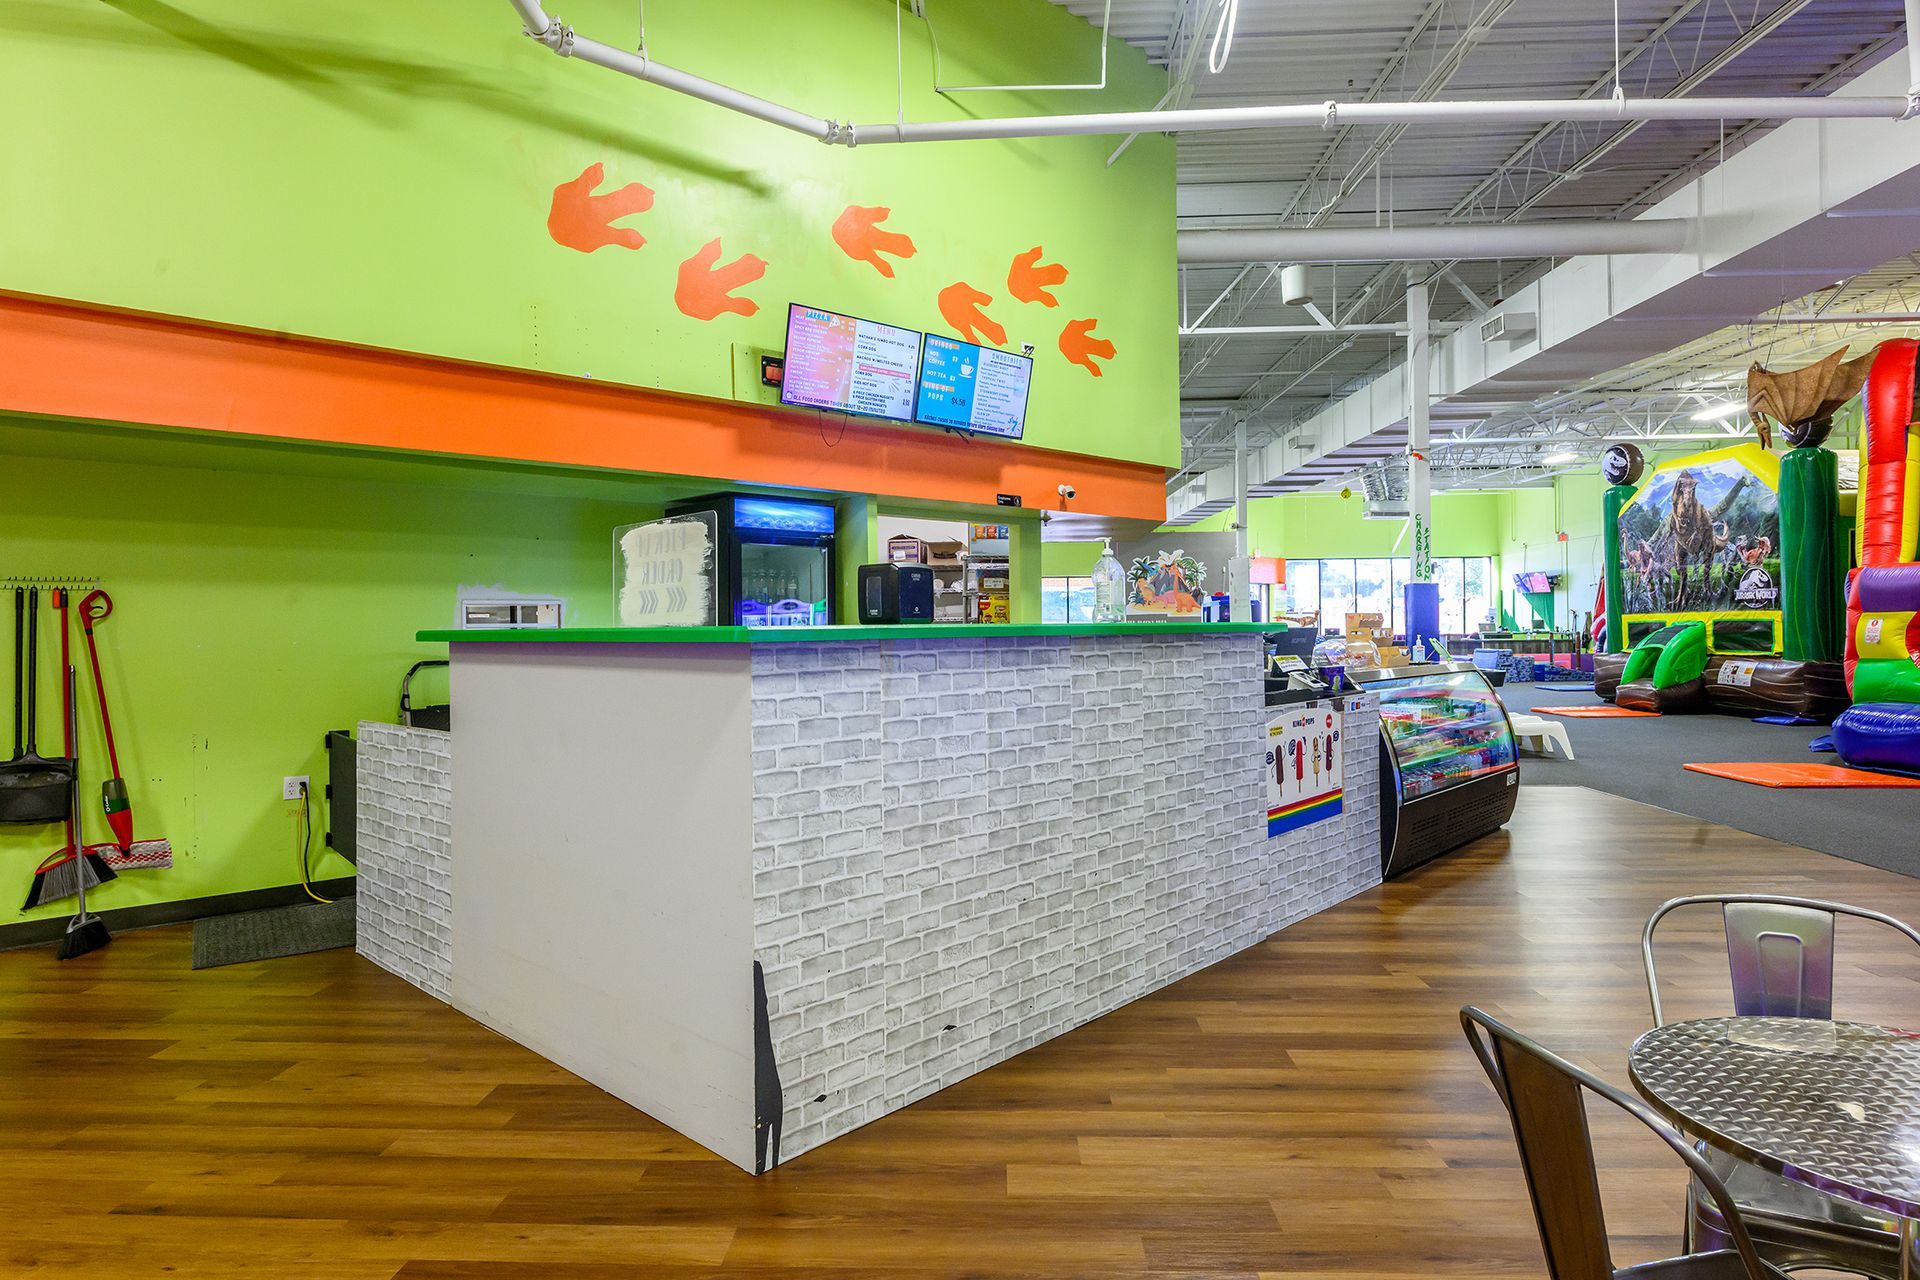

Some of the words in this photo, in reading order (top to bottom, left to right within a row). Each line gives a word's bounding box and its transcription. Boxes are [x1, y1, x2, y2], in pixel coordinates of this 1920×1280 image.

[807, 310, 828, 321] PIZZA
[877, 325, 895, 336] MENU
[858, 333, 876, 341] NATHAN'S
[930, 339, 952, 350] DRINKS
[928, 357, 945, 366] COFFEE
[991, 352, 1022, 366] SMOOTHIES
[924, 382, 938, 391] KING
[927, 392, 943, 401] POPS
[868, 406, 885, 414] MINUTES
[1735, 589, 1755, 600] JURASSIC
[1755, 588, 1777, 600] WORLD
[1292, 719, 1302, 728] KING
[1306, 717, 1314, 725] POPS
